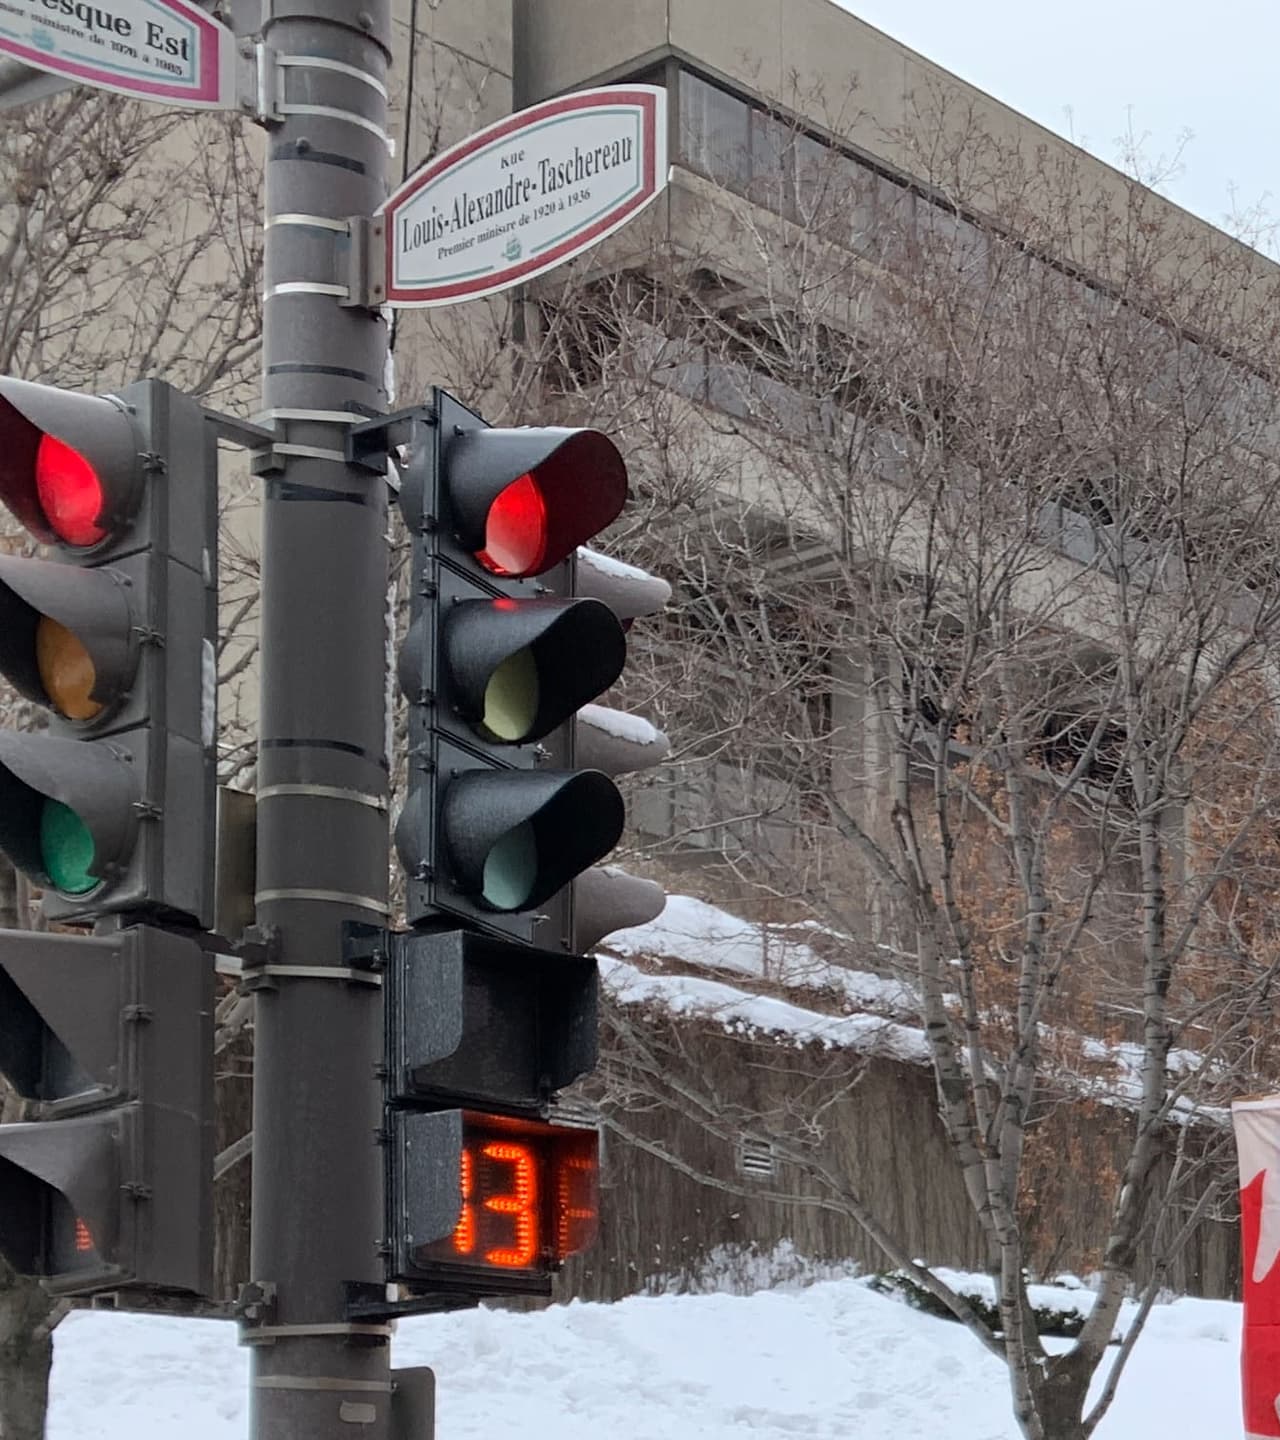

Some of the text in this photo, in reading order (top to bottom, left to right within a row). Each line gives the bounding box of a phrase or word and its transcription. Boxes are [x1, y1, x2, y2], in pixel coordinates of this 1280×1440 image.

[145, 21, 189, 61] Est
[402, 136, 633, 254] Louis-Alexandre-Taschereau
[437, 238, 475, 260] Premier
[477, 220, 517, 245] ministre
[518, 213, 531, 227] de
[533, 201, 556, 221] 1920
[567, 189, 592, 208] 1936
